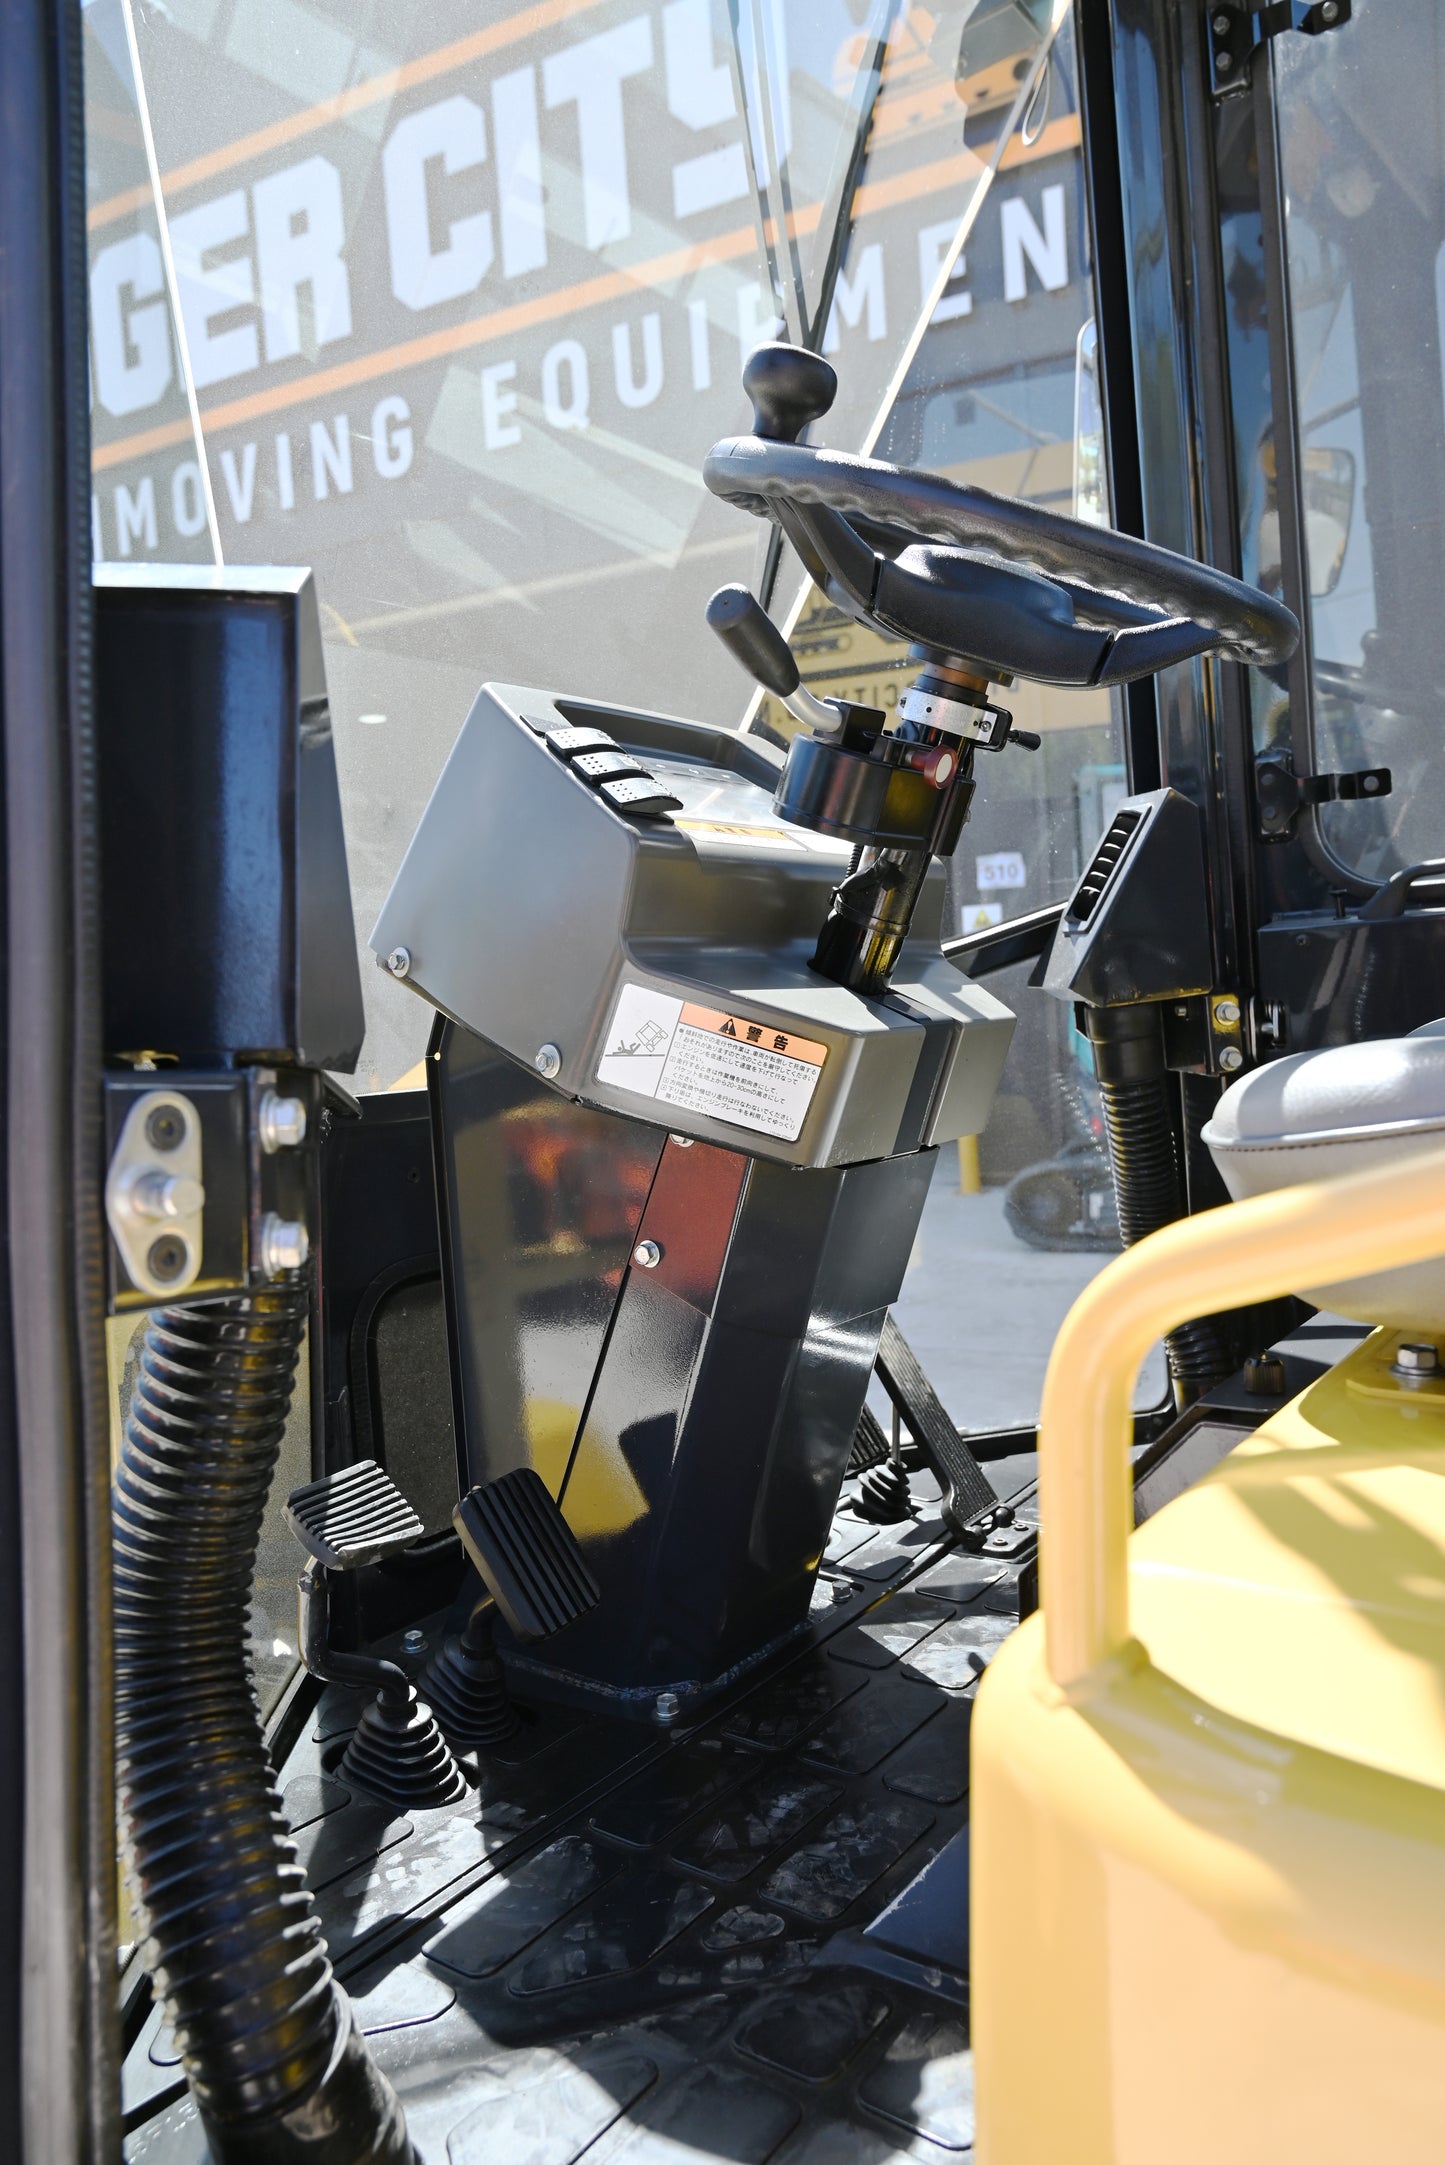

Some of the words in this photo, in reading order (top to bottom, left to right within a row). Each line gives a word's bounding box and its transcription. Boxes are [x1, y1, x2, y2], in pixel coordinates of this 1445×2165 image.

[88, 155, 353, 417] GER
[983, 863, 1019, 880] 510
[746, 1025, 789, 1051] 警告
